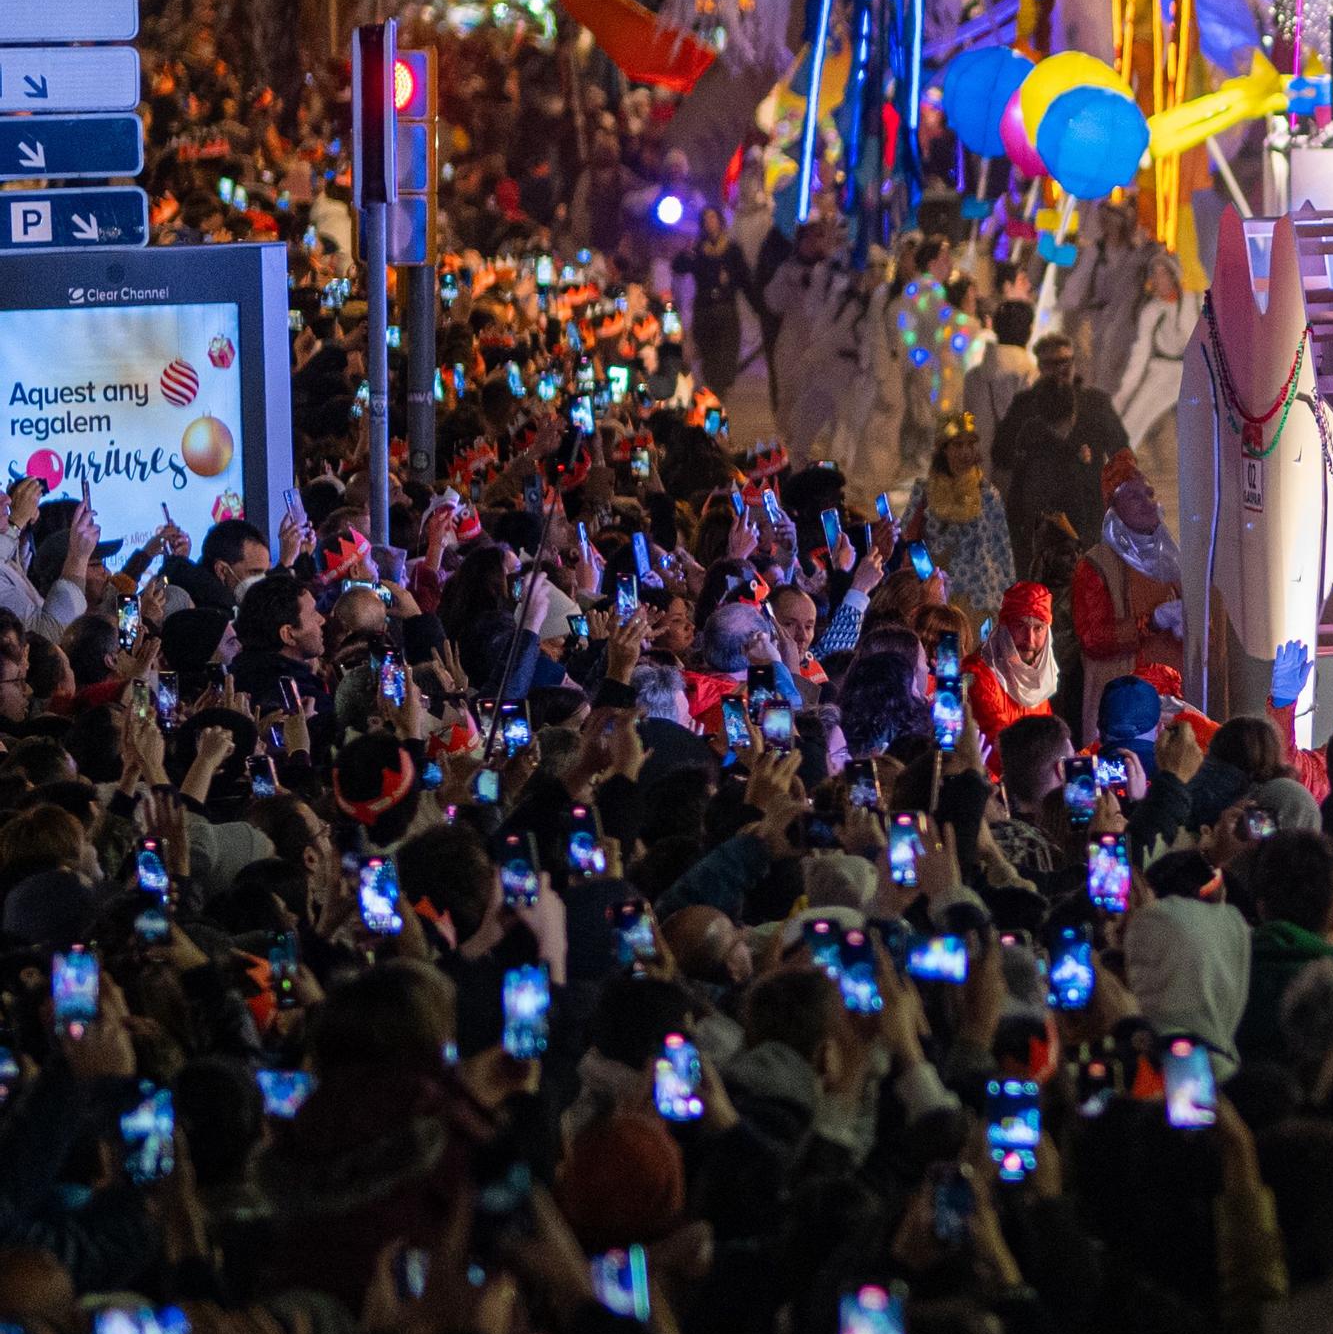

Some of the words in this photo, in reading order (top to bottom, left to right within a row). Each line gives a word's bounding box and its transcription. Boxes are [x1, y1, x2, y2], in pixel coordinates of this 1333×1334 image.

[22, 209, 42, 236] P
[87, 288, 119, 302] Clear
[120, 286, 170, 301] Channel
[9, 381, 96, 410] Aquest
[103, 382, 149, 407] any
[10, 413, 111, 441] regalem
[1247, 462, 1257, 489] 02
